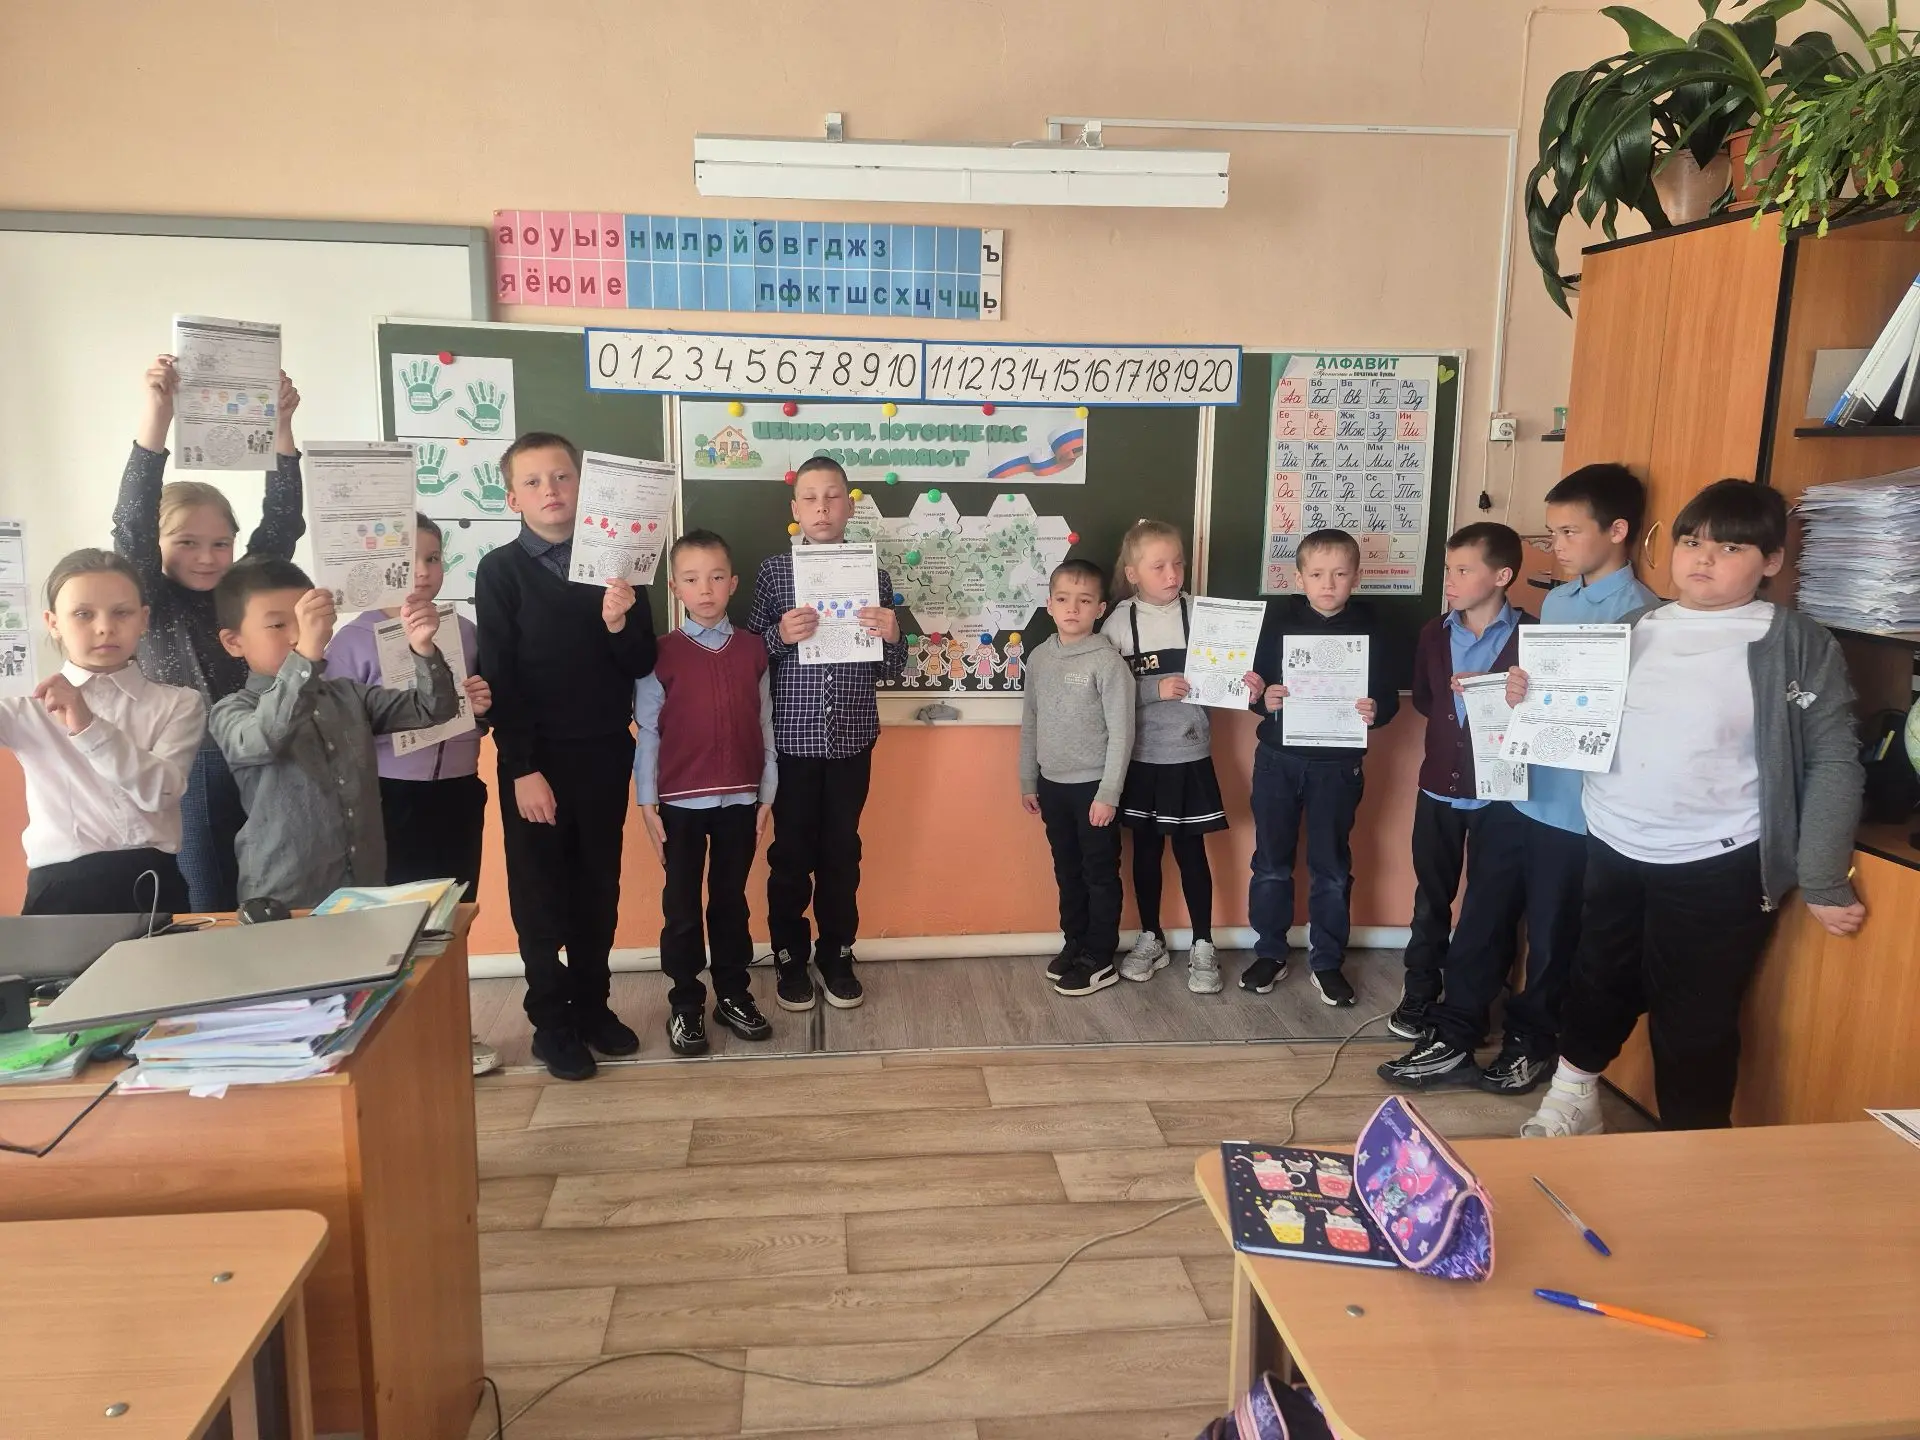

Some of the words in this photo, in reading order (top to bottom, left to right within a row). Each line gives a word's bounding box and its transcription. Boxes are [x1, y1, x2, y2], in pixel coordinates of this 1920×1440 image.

[499, 227, 513, 244] а
[523, 227, 539, 245] о
[550, 228, 564, 251] у
[575, 229, 596, 246] ы
[606, 230, 619, 247] э
[631, 231, 645, 248] н
[656, 232, 673, 249] м
[682, 233, 697, 250] л
[708, 234, 722, 257] р
[734, 229, 747, 253] й
[759, 230, 773, 252] б
[784, 237, 798, 254] в
[808, 238, 818, 255] г
[825, 239, 842, 260] д
[848, 239, 866, 256] ж
[874, 240, 886, 257] з
[983, 245, 999, 262] ъ
[501, 275, 515, 291] я
[526, 269, 540, 292] ё
[549, 276, 570, 293] ю
[581, 277, 595, 294] и
[608, 278, 621, 295] е
[761, 283, 774, 300] п
[779, 279, 801, 307] ф
[808, 286, 819, 302] к
[827, 286, 840, 302] т
[848, 287, 866, 303] ш
[874, 287, 887, 304] с
[896, 288, 909, 305] х
[916, 289, 930, 310] ц
[939, 290, 951, 307] ч
[959, 291, 978, 312] щ
[984, 293, 997, 308] ь
[599, 344, 618, 377] 0
[631, 345, 643, 378] 1
[652, 346, 673, 379] 2
[685, 347, 703, 381] 3
[715, 348, 733, 382] 4
[746, 349, 766, 383] 5
[777, 350, 797, 384] 6
[806, 351, 825, 385] 7
[833, 352, 852, 385] 8
[861, 353, 880, 386] 9
[888, 354, 916, 387] 10
[1316, 358, 1399, 370] АЛФАВИТ
[931, 356, 954, 389] 11
[959, 357, 984, 389] 12
[991, 358, 1015, 390] 13
[1022, 358, 1046, 391] 14
[1054, 359, 1080, 392] 15
[1085, 359, 1111, 392] 16
[1116, 360, 1143, 392] 17
[1146, 360, 1171, 392] 18
[1174, 360, 1198, 392] 19
[1200, 359, 1232, 392] 20
[1281, 389, 1301, 404] Аа
[1312, 389, 1336, 404] Бб
[1343, 389, 1361, 404] Вв
[986, 425, 1028, 443] НАС
[1338, 453, 1358, 467] Лл
[1367, 453, 1392, 468] Мм
[1400, 453, 1419, 468] Нн
[1336, 474, 1347, 482] Рр
[1278, 483, 1294, 498] Оо
[1307, 481, 1328, 498] Пп
[1370, 483, 1384, 498] Сс
[1276, 505, 1284, 513] Уу
